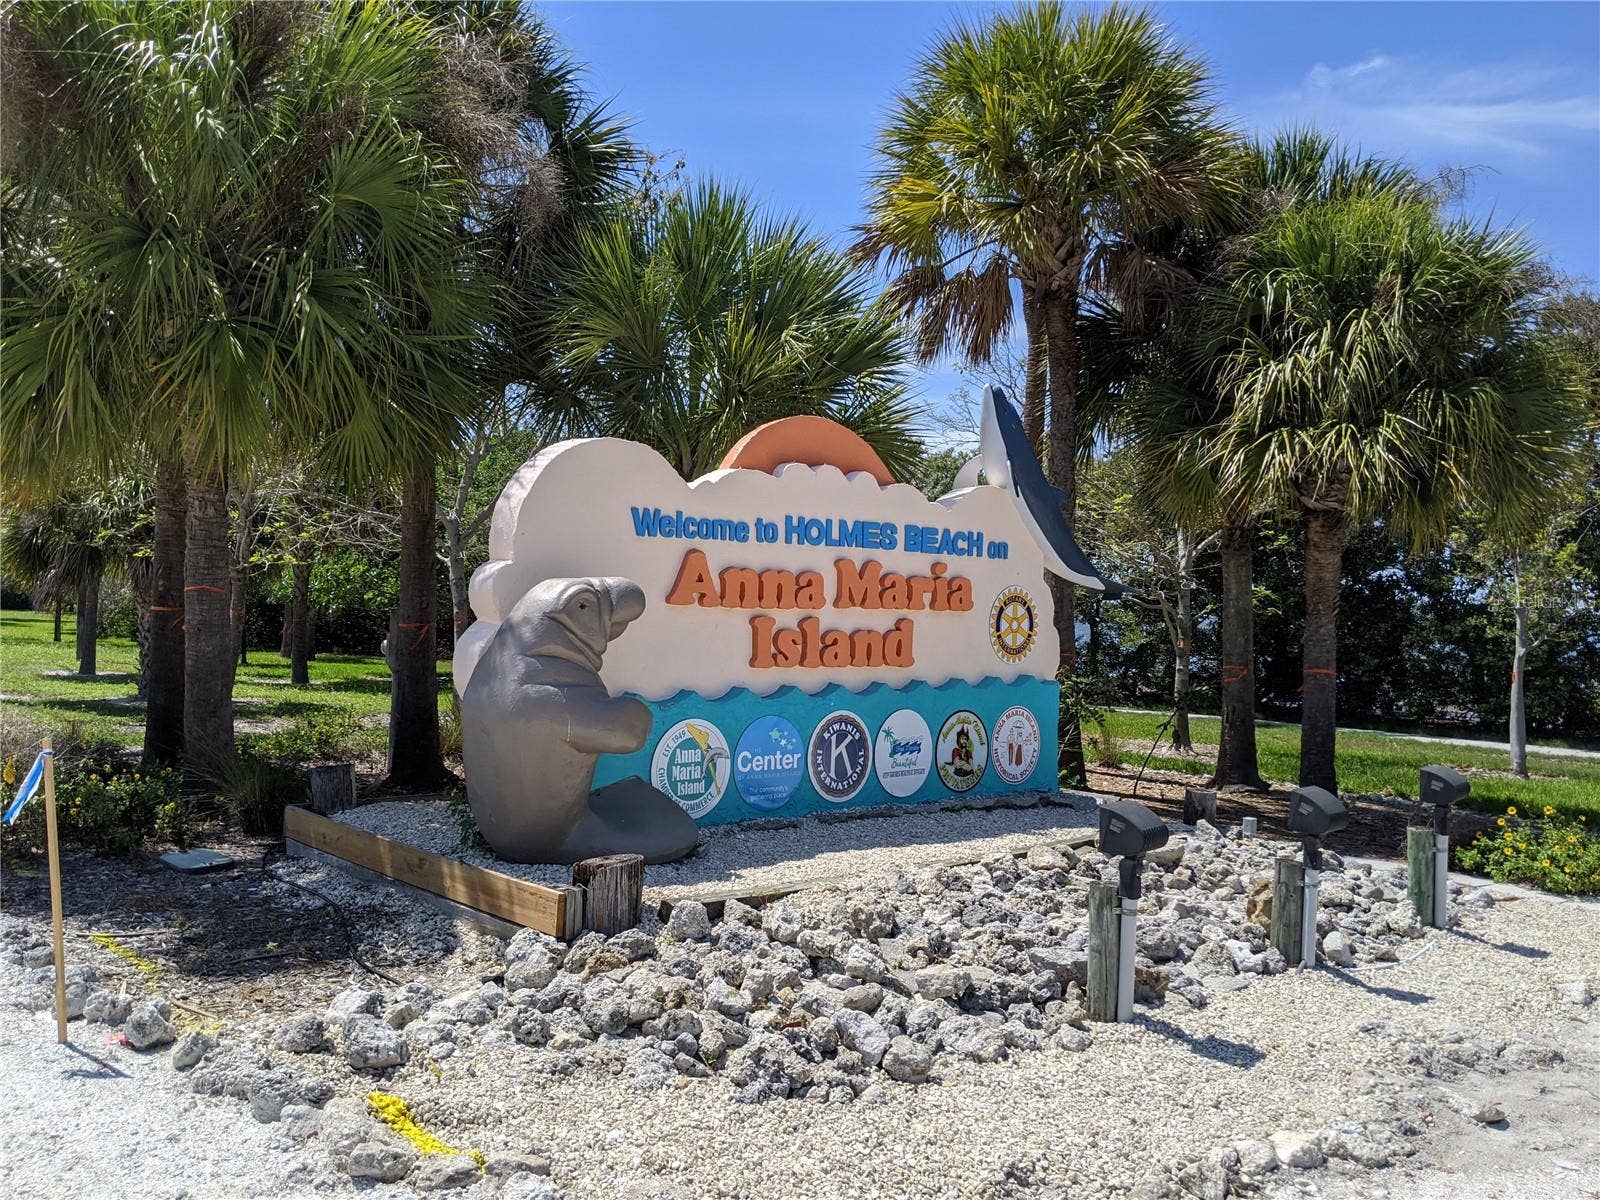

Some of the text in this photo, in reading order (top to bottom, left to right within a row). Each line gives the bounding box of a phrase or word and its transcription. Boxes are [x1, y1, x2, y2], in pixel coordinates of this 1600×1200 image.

[631, 506, 1009, 559] Welcome to HOLMES BEACH on
[665, 548, 974, 611] Anna Maria
[749, 615, 915, 668] Island
[672, 730, 686, 744] 1949
[823, 722, 861, 741] KIWANIS
[995, 710, 1038, 742] ANNA MARIA ISLAND
[674, 748, 701, 764] Anna
[737, 751, 802, 773] Center
[816, 749, 864, 790] INTERNATIONAL
[829, 731, 852, 781] K
[994, 748, 1037, 780] HISTORICAL SOCIETY
[672, 764, 701, 781] Maria
[677, 780, 705, 796] Island
